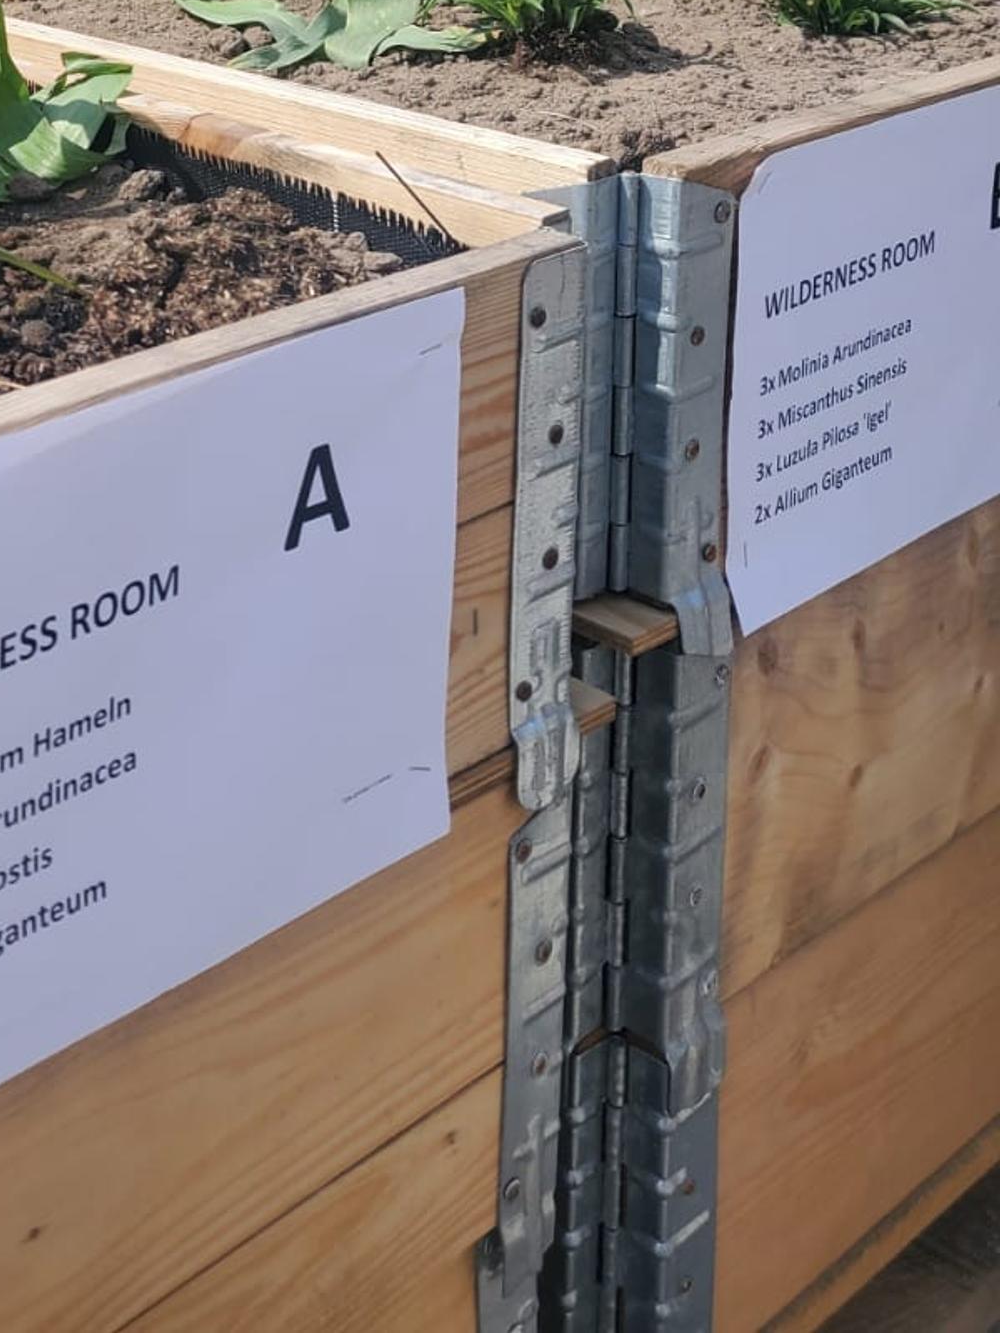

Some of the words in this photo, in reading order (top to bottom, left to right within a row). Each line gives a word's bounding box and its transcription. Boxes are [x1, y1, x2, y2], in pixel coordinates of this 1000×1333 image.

[765, 253, 876, 318] WILDERNESS
[882, 231, 934, 271] ROOM
[760, 376, 775, 396] 3x
[779, 354, 829, 387] Molinia
[833, 320, 911, 364] Arundinacea
[758, 420, 773, 439] 3x
[778, 384, 853, 430] Miscanthus
[857, 361, 907, 394] Sinensis
[755, 505, 771, 524] 2x
[775, 482, 817, 515] Allium
[822, 447, 892, 490] Giganteum
[756, 463, 772, 482] 3x
[777, 440, 818, 472] Luzula
[823, 422, 859, 450] Pilosa
[284, 444, 350, 551] A
[72, 565, 179, 639] ROOM
[34, 697, 130, 756] Hameln
